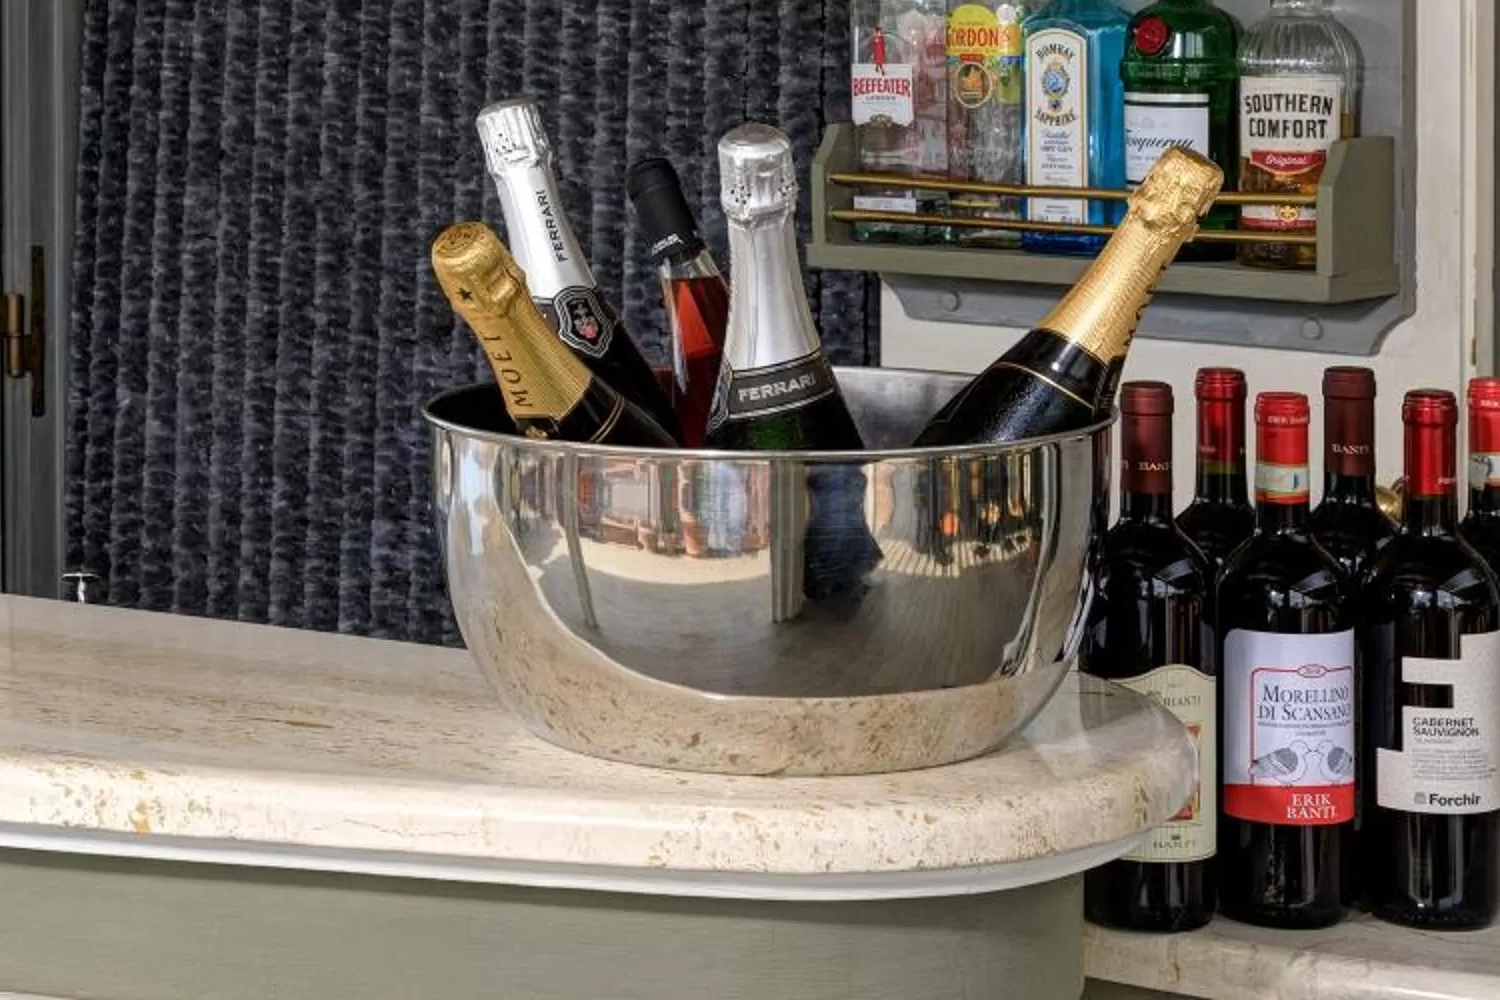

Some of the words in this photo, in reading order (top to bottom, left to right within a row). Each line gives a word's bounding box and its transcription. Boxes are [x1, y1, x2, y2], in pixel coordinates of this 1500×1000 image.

[853, 77, 911, 97] BEEFEATER
[1245, 93, 1333, 116] SOUTHERN
[1034, 108, 1077, 127] SAPPHIRE
[1249, 118, 1327, 139] COMFORT
[535, 189, 569, 263] FERRARI
[737, 372, 817, 403] FERRARI
[1262, 684, 1350, 704] MORELLINO
[1258, 704, 1276, 721] DI
[1412, 717, 1475, 728] CABERNET
[1412, 727, 1480, 737] SAUVIGNON
[1291, 794, 1332, 807] ERIK
[1429, 792, 1481, 807] Forchir
